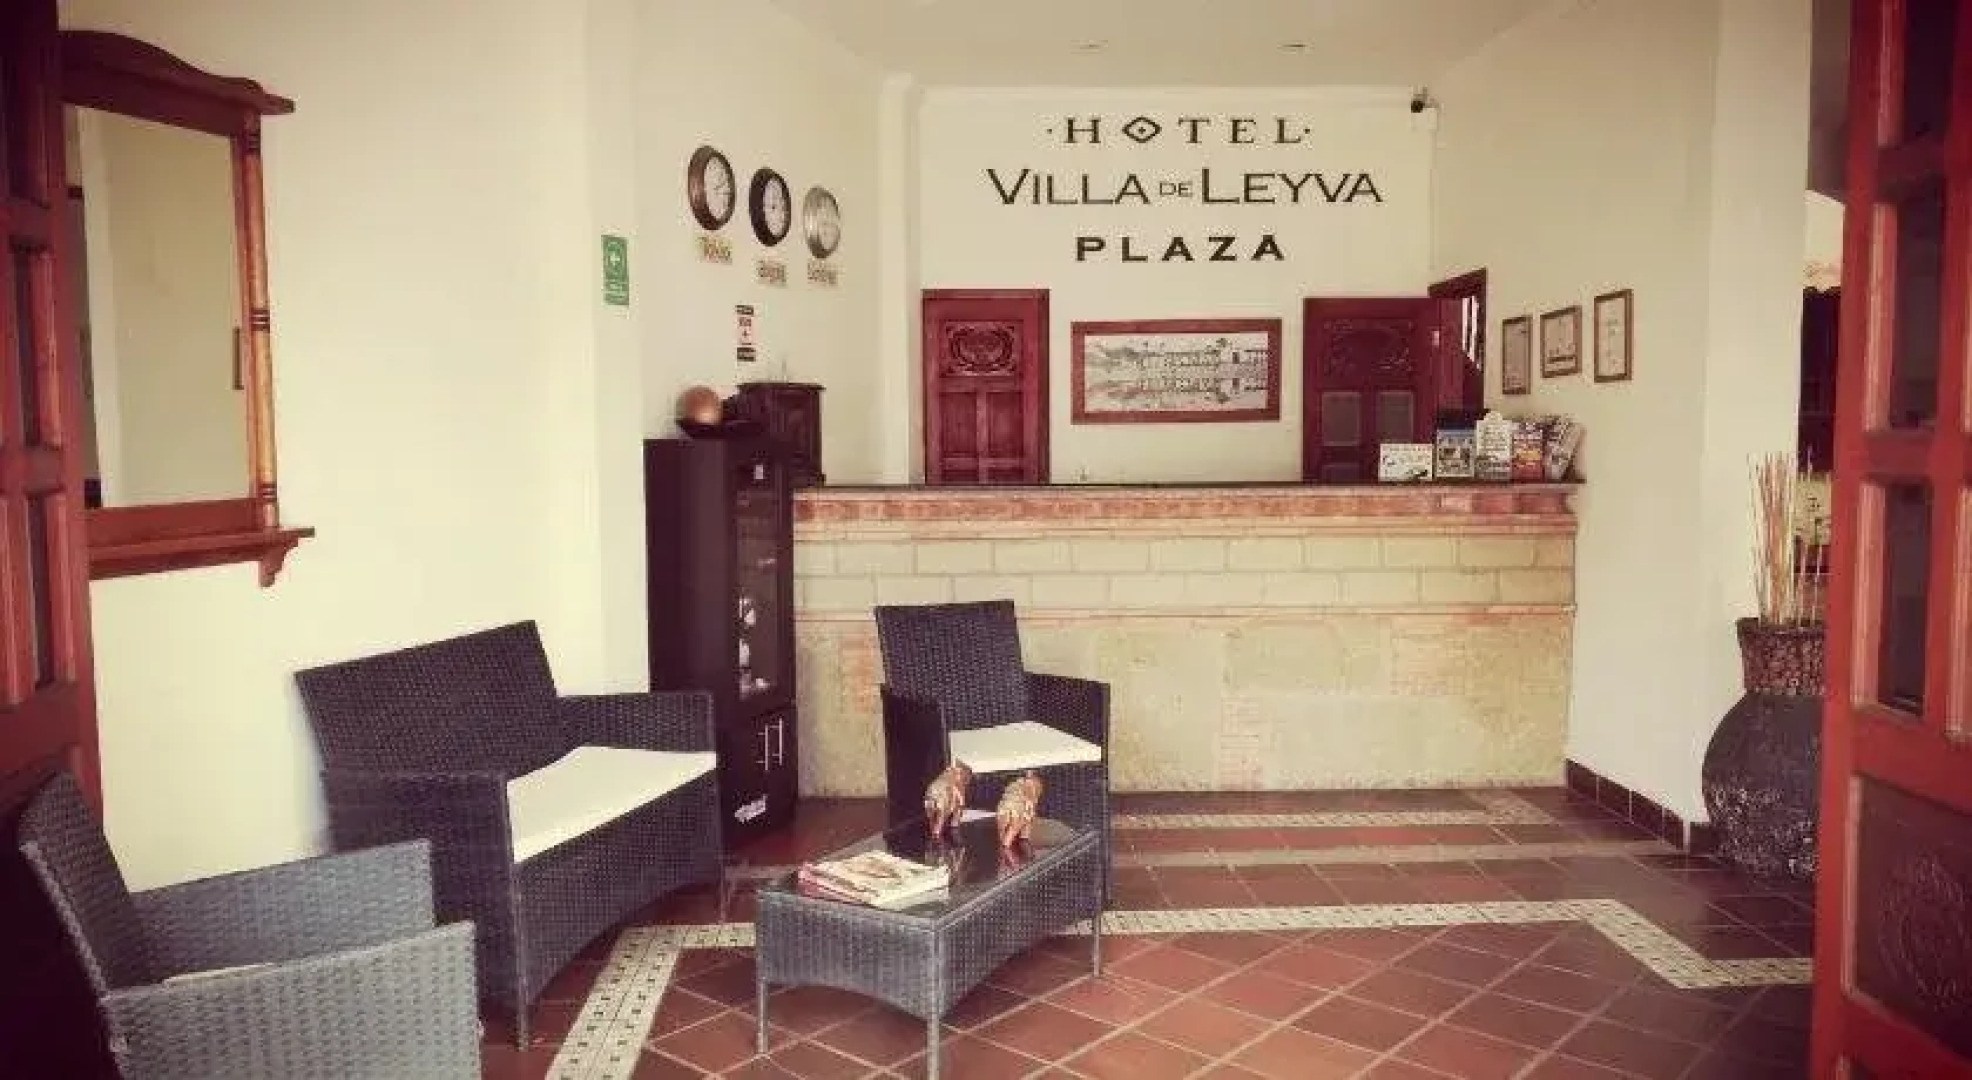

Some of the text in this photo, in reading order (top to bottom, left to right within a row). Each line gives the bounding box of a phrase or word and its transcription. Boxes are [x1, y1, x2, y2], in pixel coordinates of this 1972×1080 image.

[986, 168, 1383, 205] VILLA DE LEYVA
[1076, 234, 1285, 262] PLAZA
